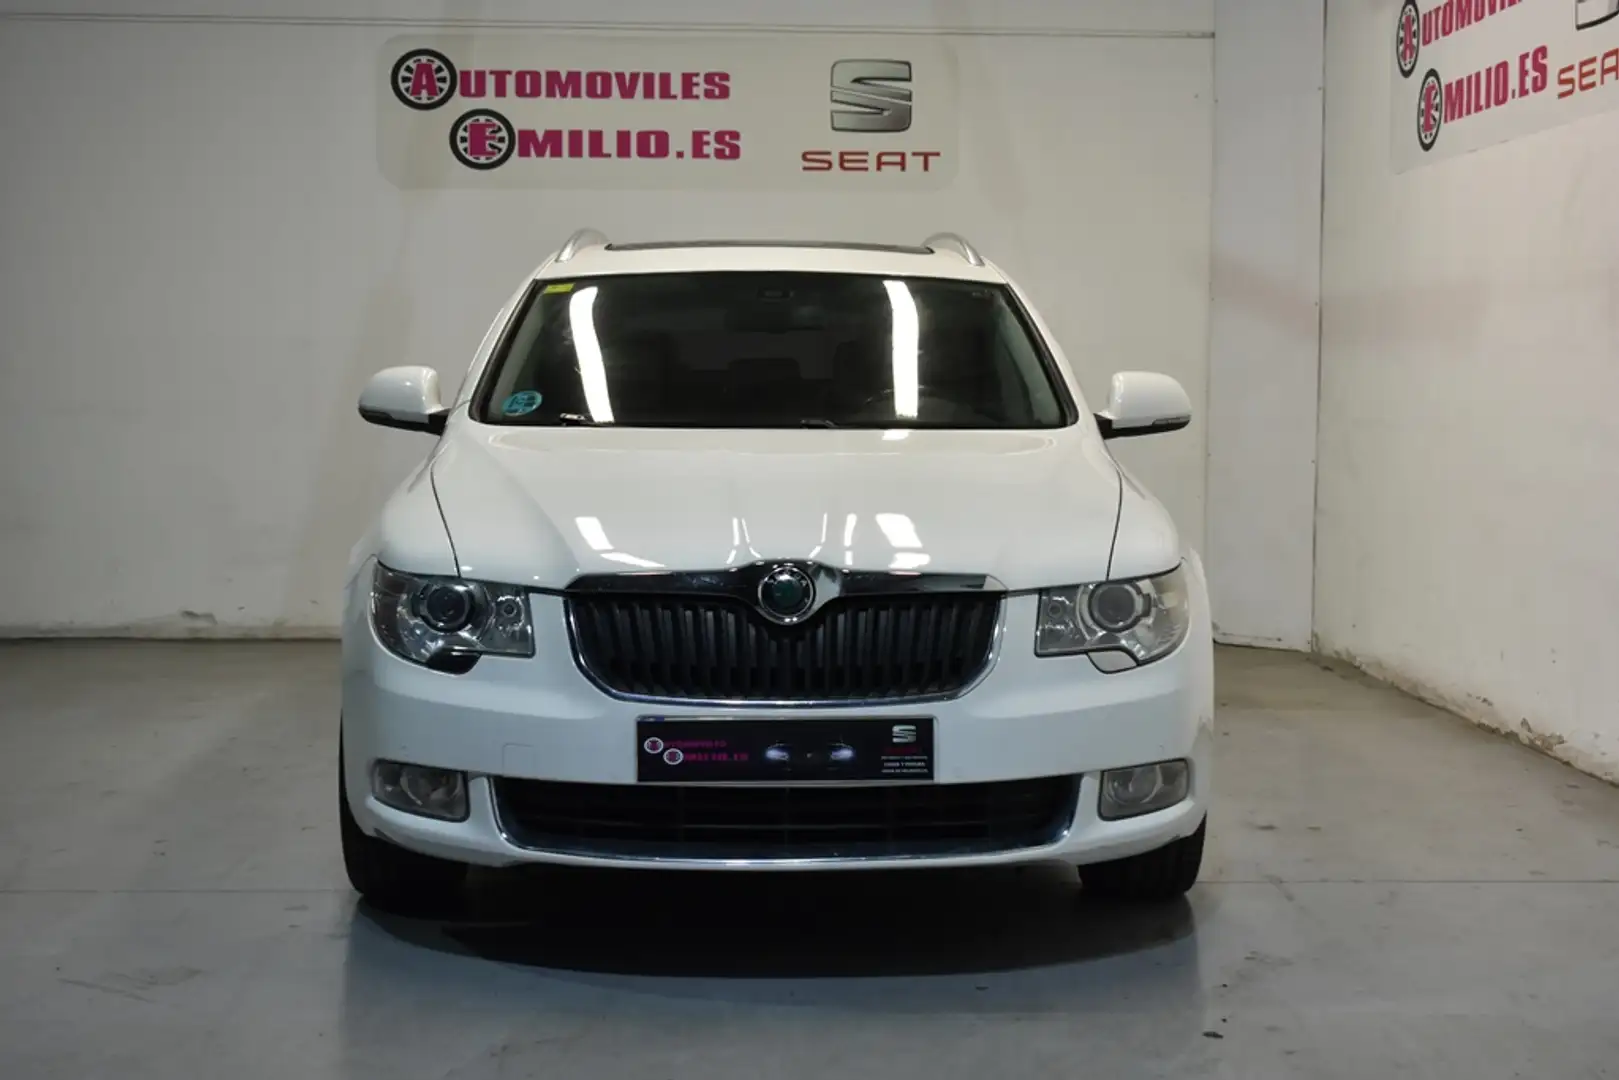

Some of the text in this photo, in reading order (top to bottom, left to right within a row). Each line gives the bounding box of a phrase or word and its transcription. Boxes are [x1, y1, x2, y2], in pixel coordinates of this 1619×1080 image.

[410, 63, 731, 100] AUTOMOVILES
[1422, 45, 1548, 133] EMILIO.ES
[467, 121, 741, 161] EMILIO.ES
[802, 151, 941, 172] SEAT
